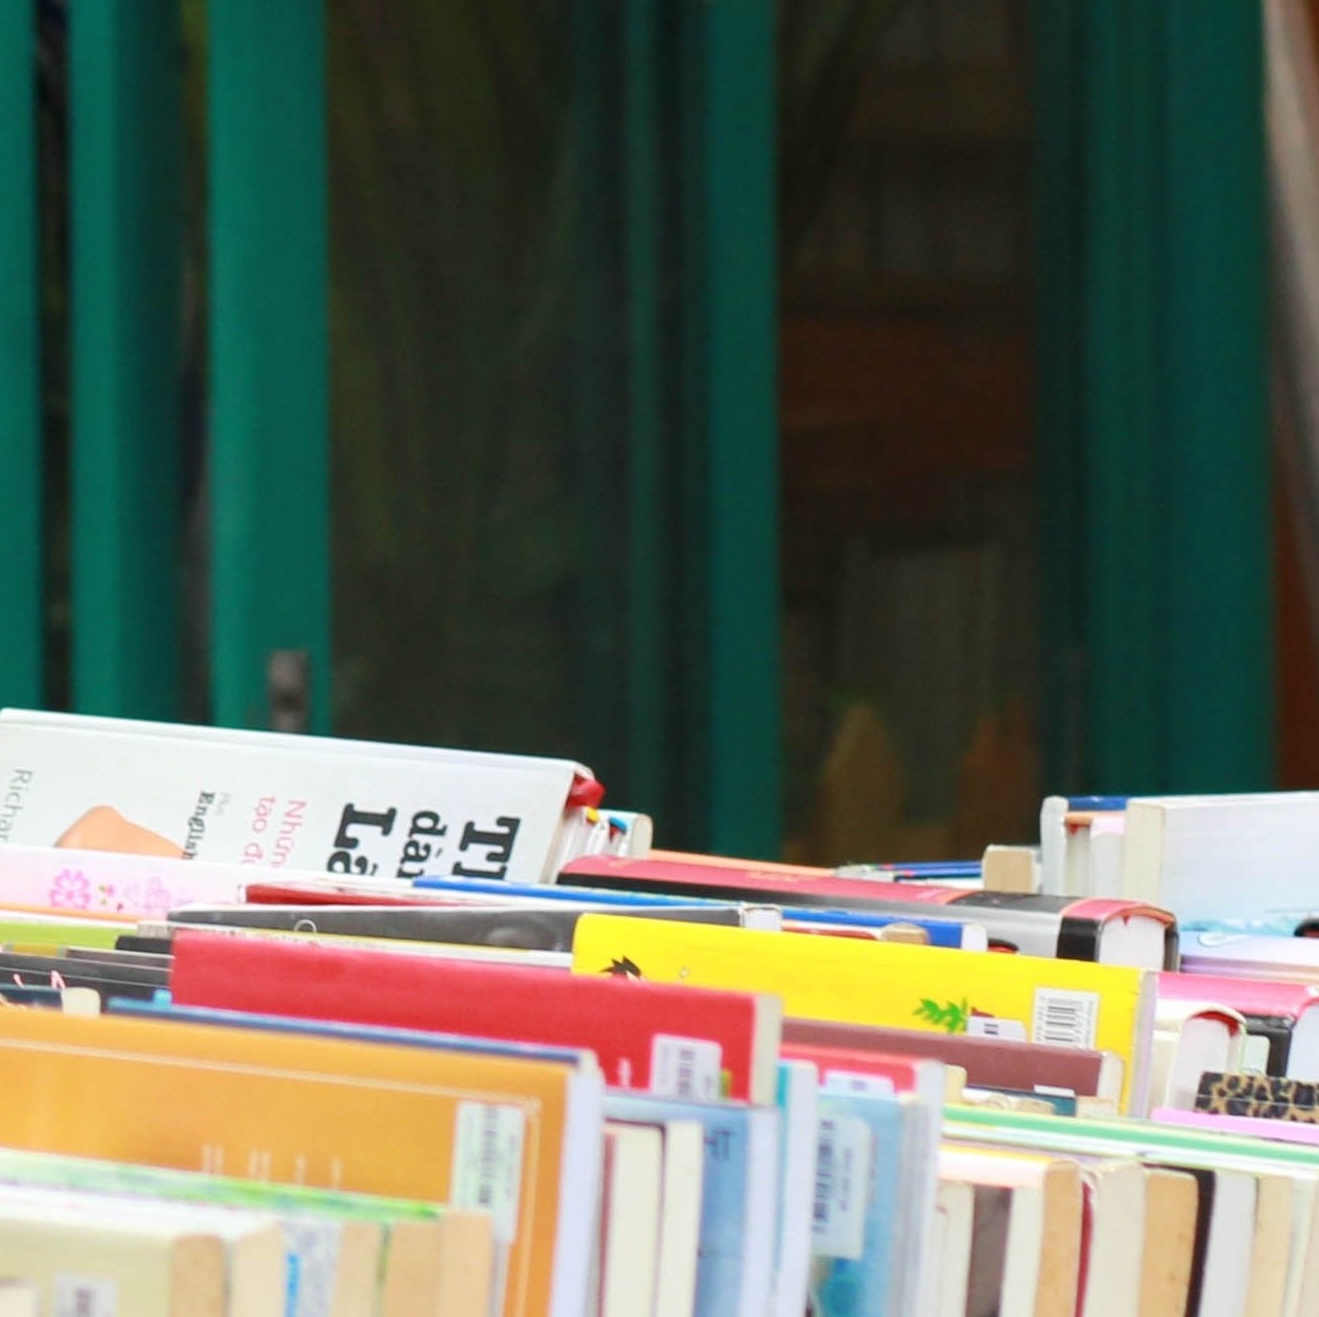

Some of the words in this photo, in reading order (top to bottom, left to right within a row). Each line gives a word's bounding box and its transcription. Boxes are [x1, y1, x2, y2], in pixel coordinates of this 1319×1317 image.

[181, 790, 215, 860] English
[253, 797, 276, 833] tạo
[270, 799, 307, 869] Nhữn
